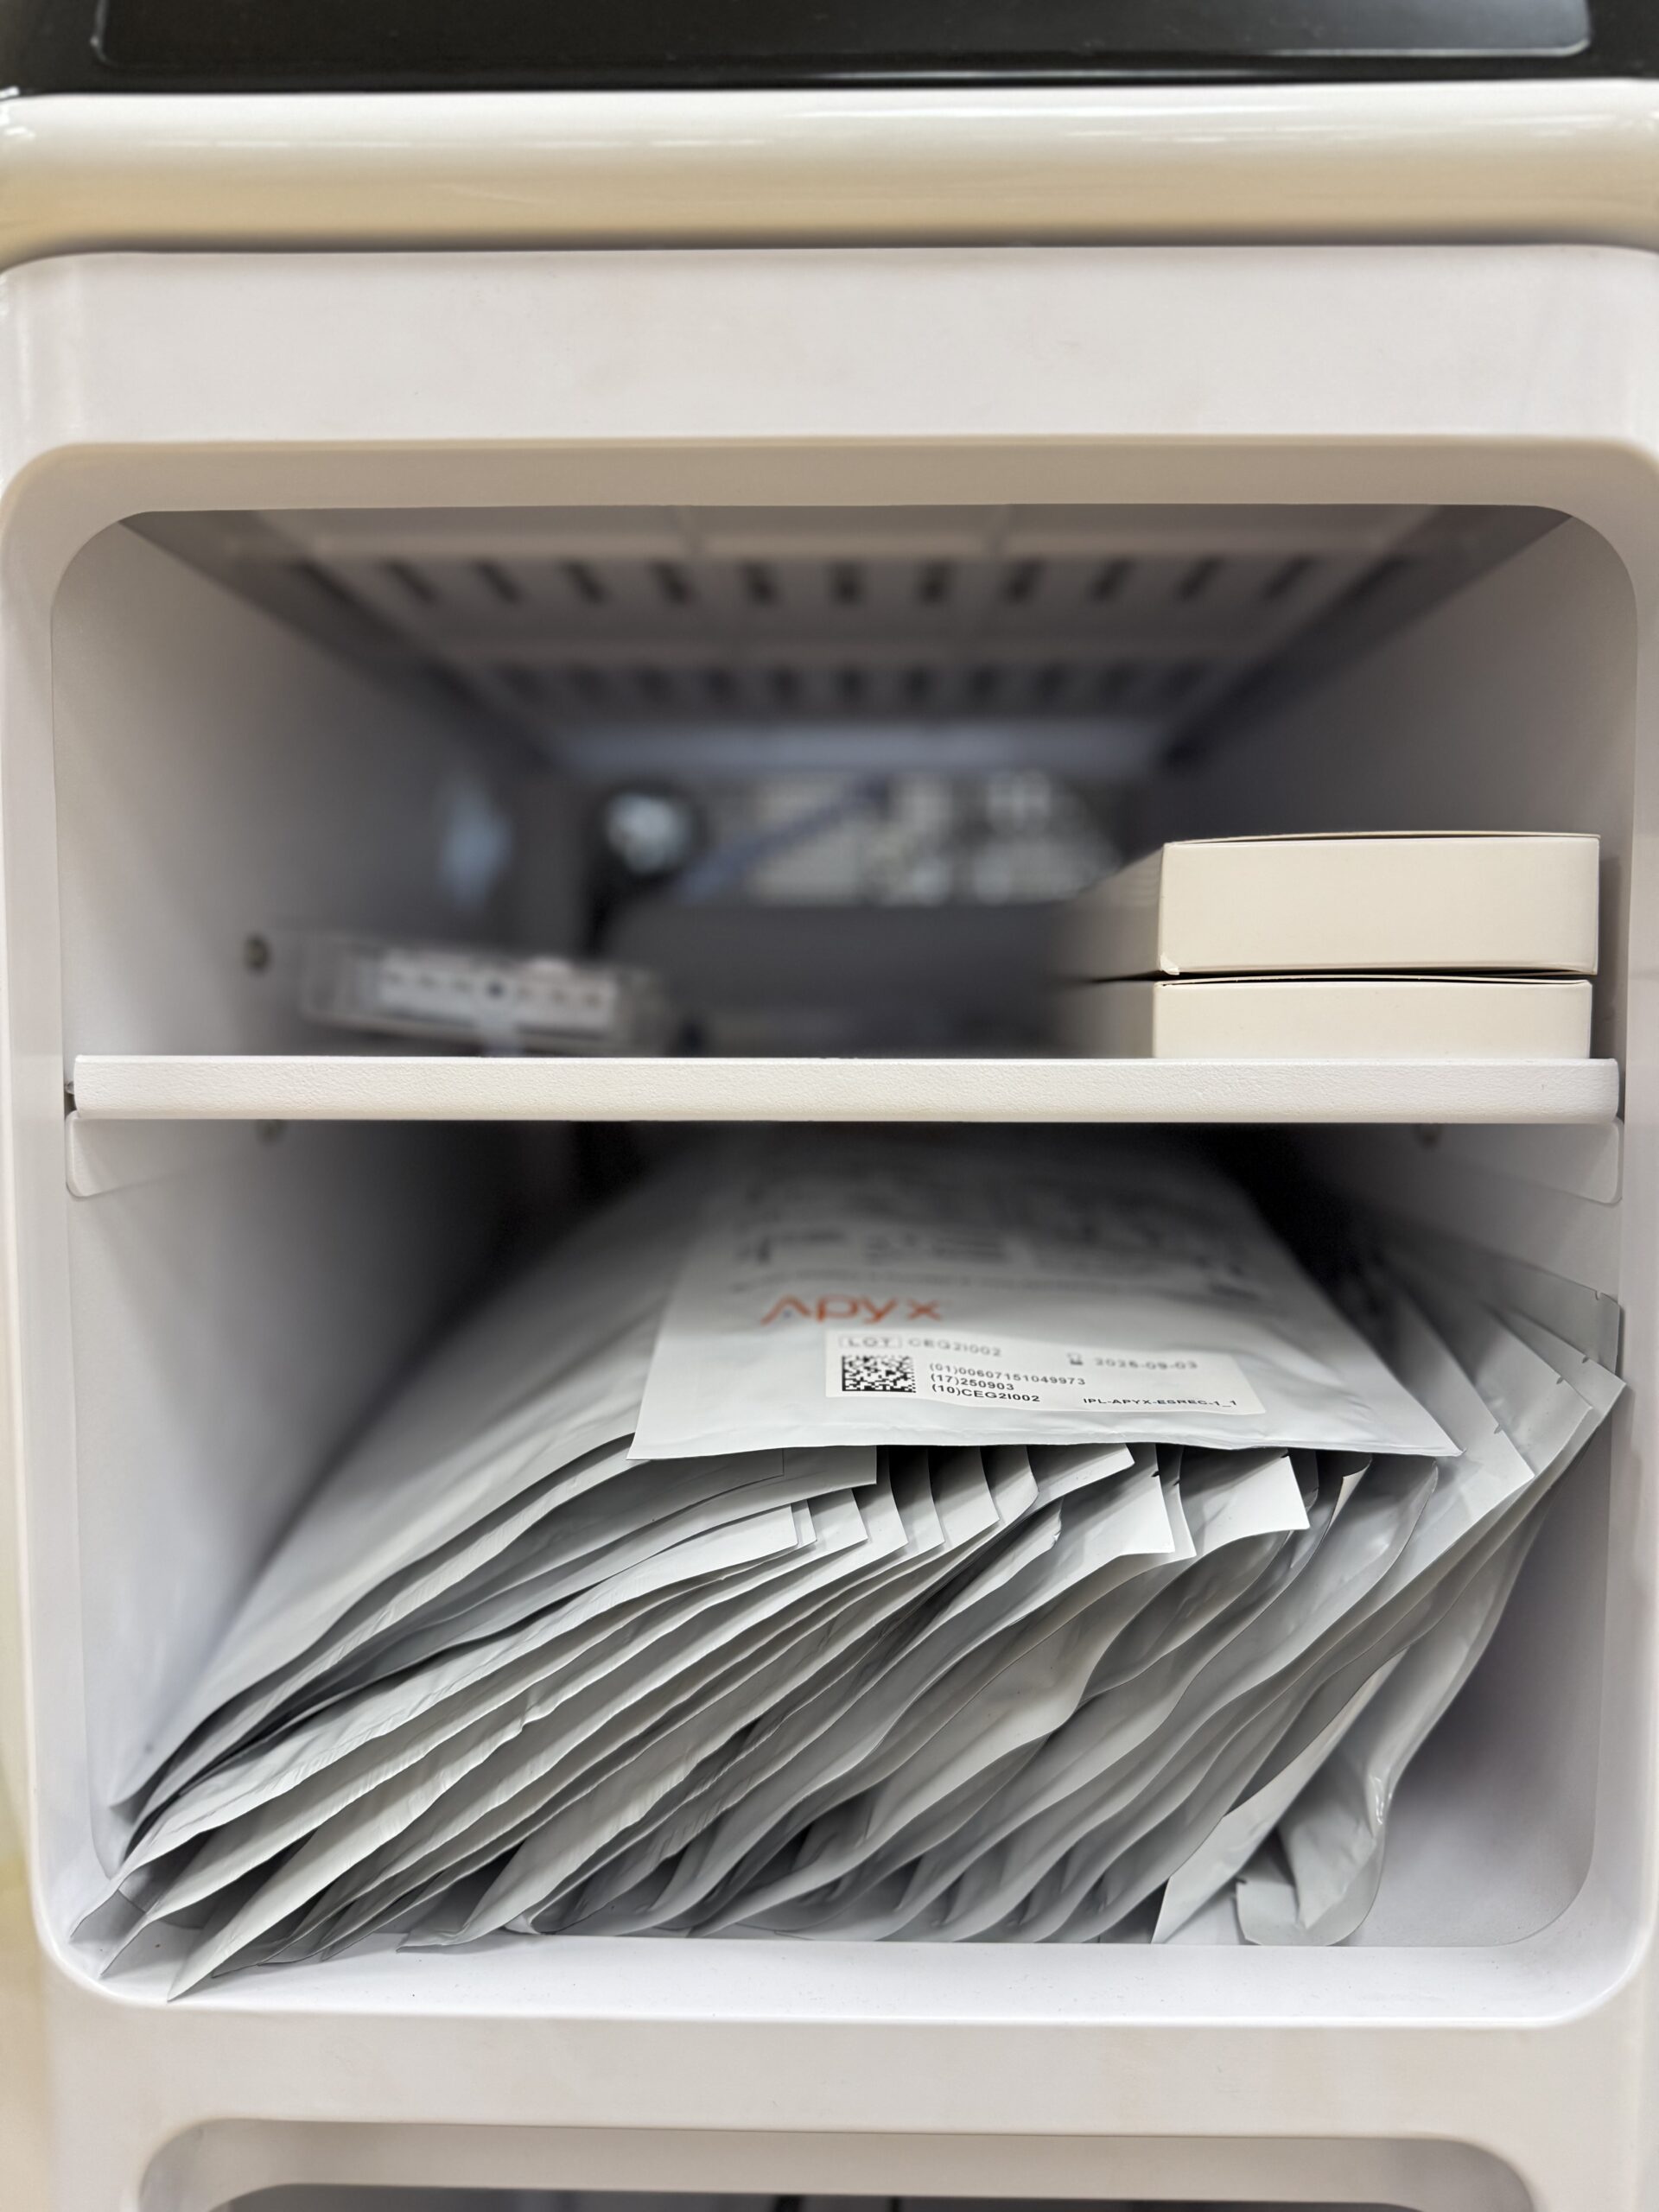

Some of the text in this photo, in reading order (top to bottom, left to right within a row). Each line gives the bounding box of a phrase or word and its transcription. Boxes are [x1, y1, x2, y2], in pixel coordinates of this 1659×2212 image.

[848, 1336, 891, 1348] LOT
[929, 1363, 1086, 1385] (01)00607151049973
[931, 1373, 1014, 1391] (17)250903
